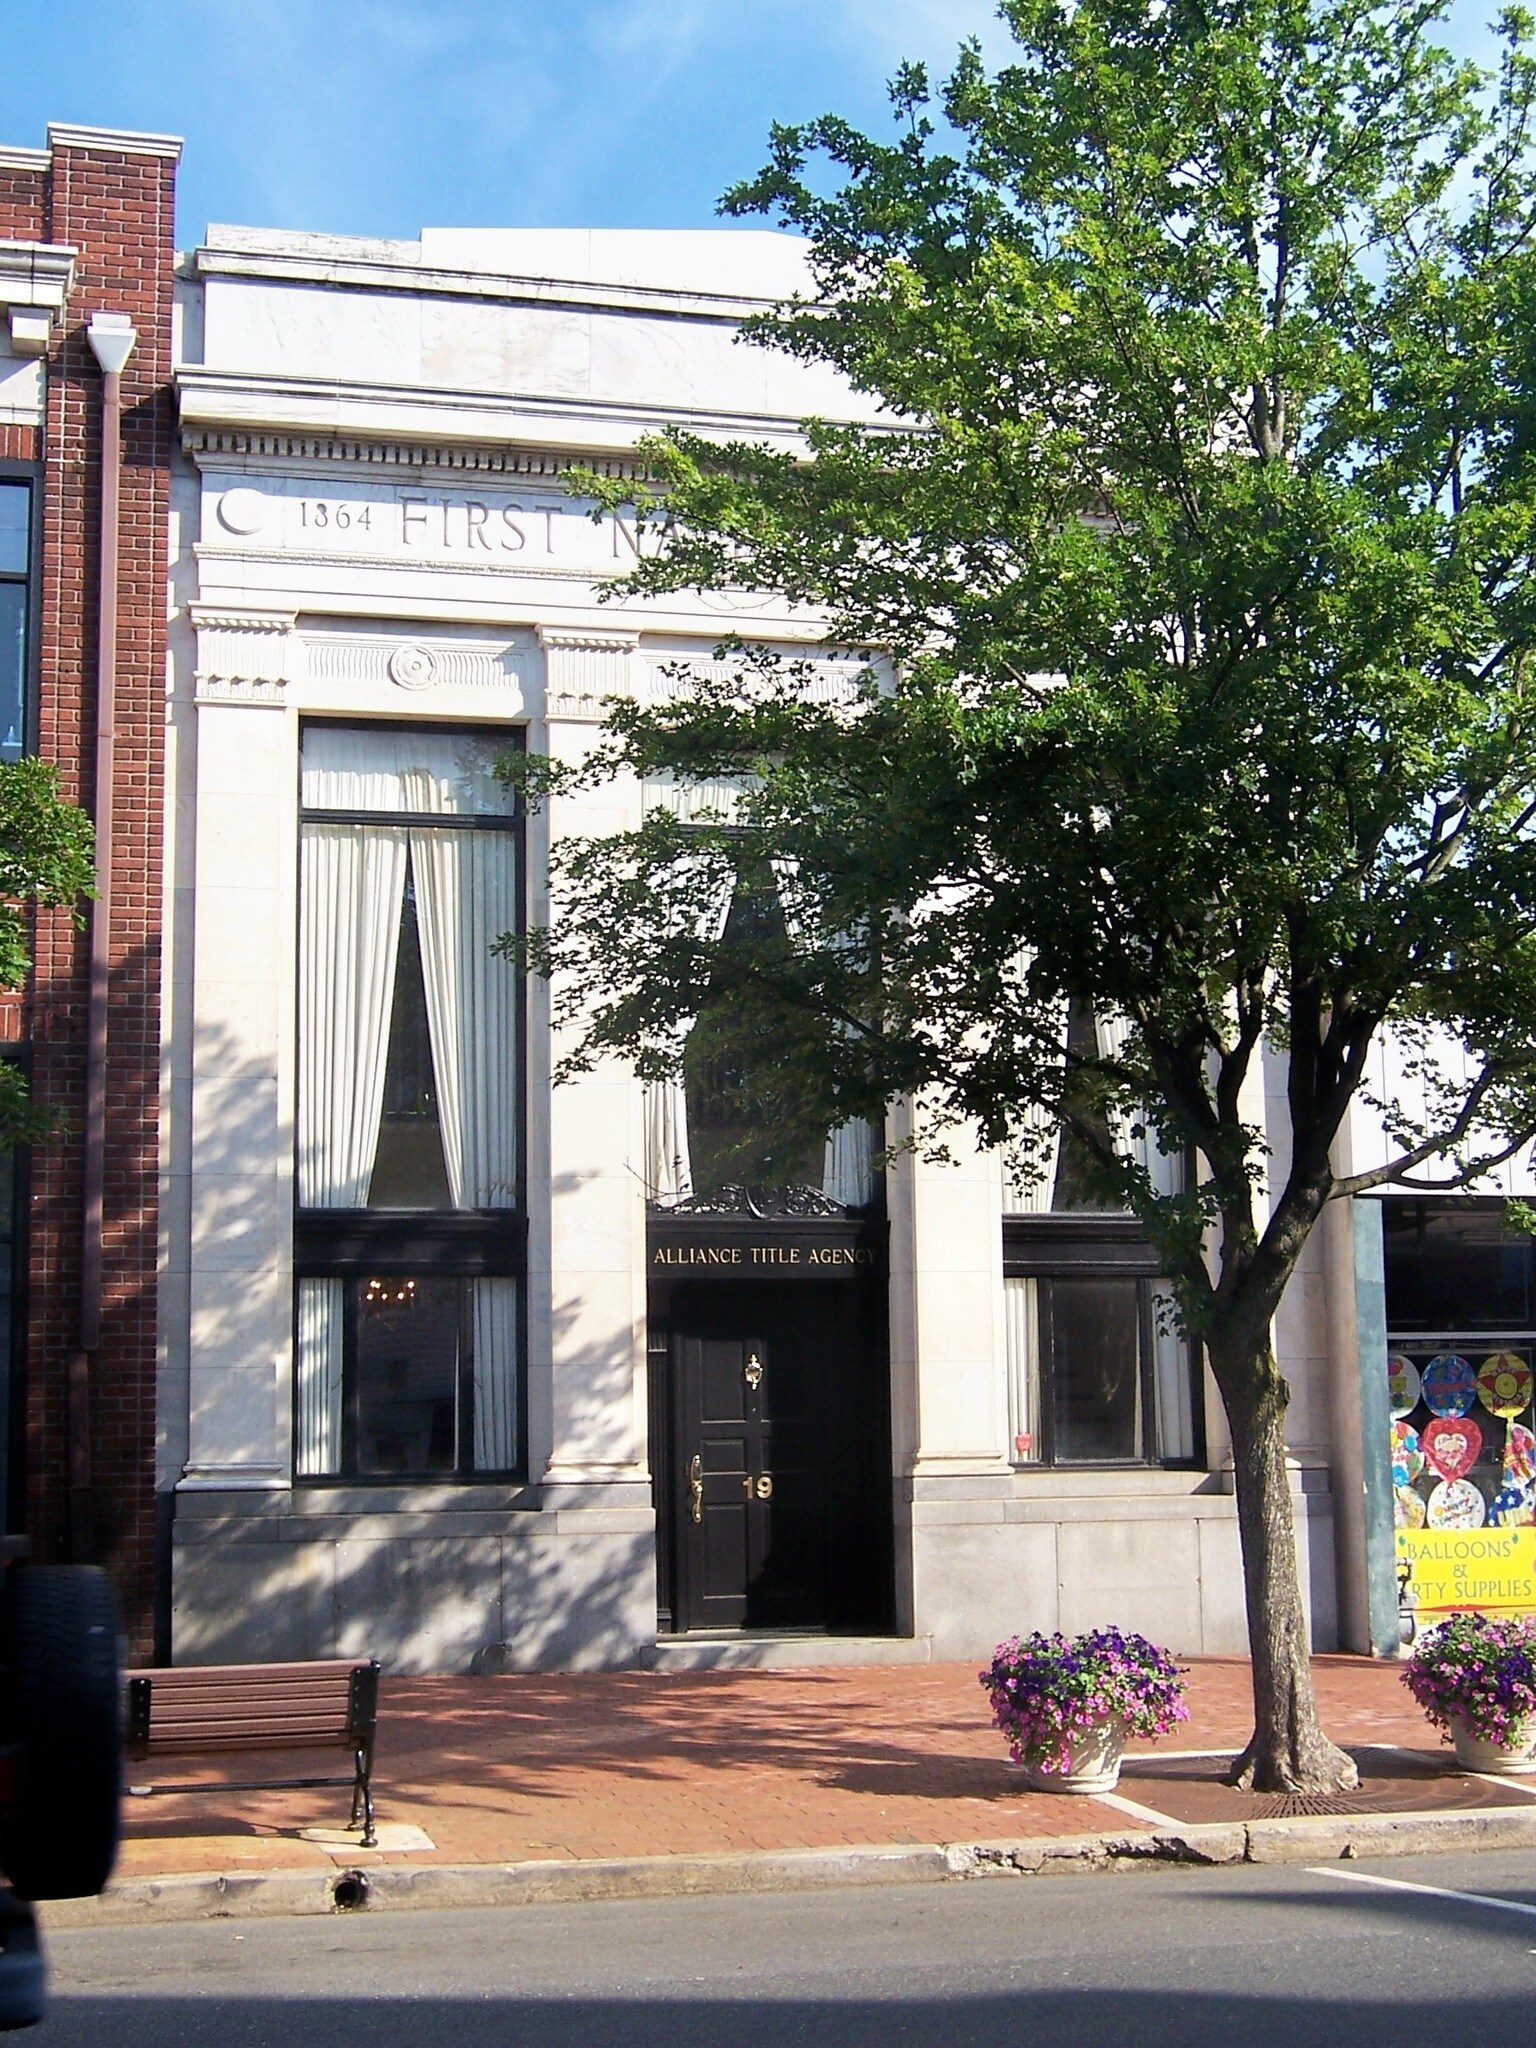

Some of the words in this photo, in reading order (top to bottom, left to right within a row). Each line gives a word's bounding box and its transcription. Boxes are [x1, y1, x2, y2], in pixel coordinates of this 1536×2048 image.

[300, 501, 371, 530] 1864
[398, 495, 563, 554] FIRST
[653, 1248, 742, 1264] ALLIANCE
[751, 1248, 800, 1264] TITLE
[808, 1248, 876, 1265] AGENCY
[742, 1476, 773, 1500] 19
[1407, 1540, 1511, 1560] BALLOONS
[1453, 1563, 1469, 1578] &
[1412, 1582, 1446, 1600] RTY
[1455, 1579, 1532, 1598] SUPPLIES
